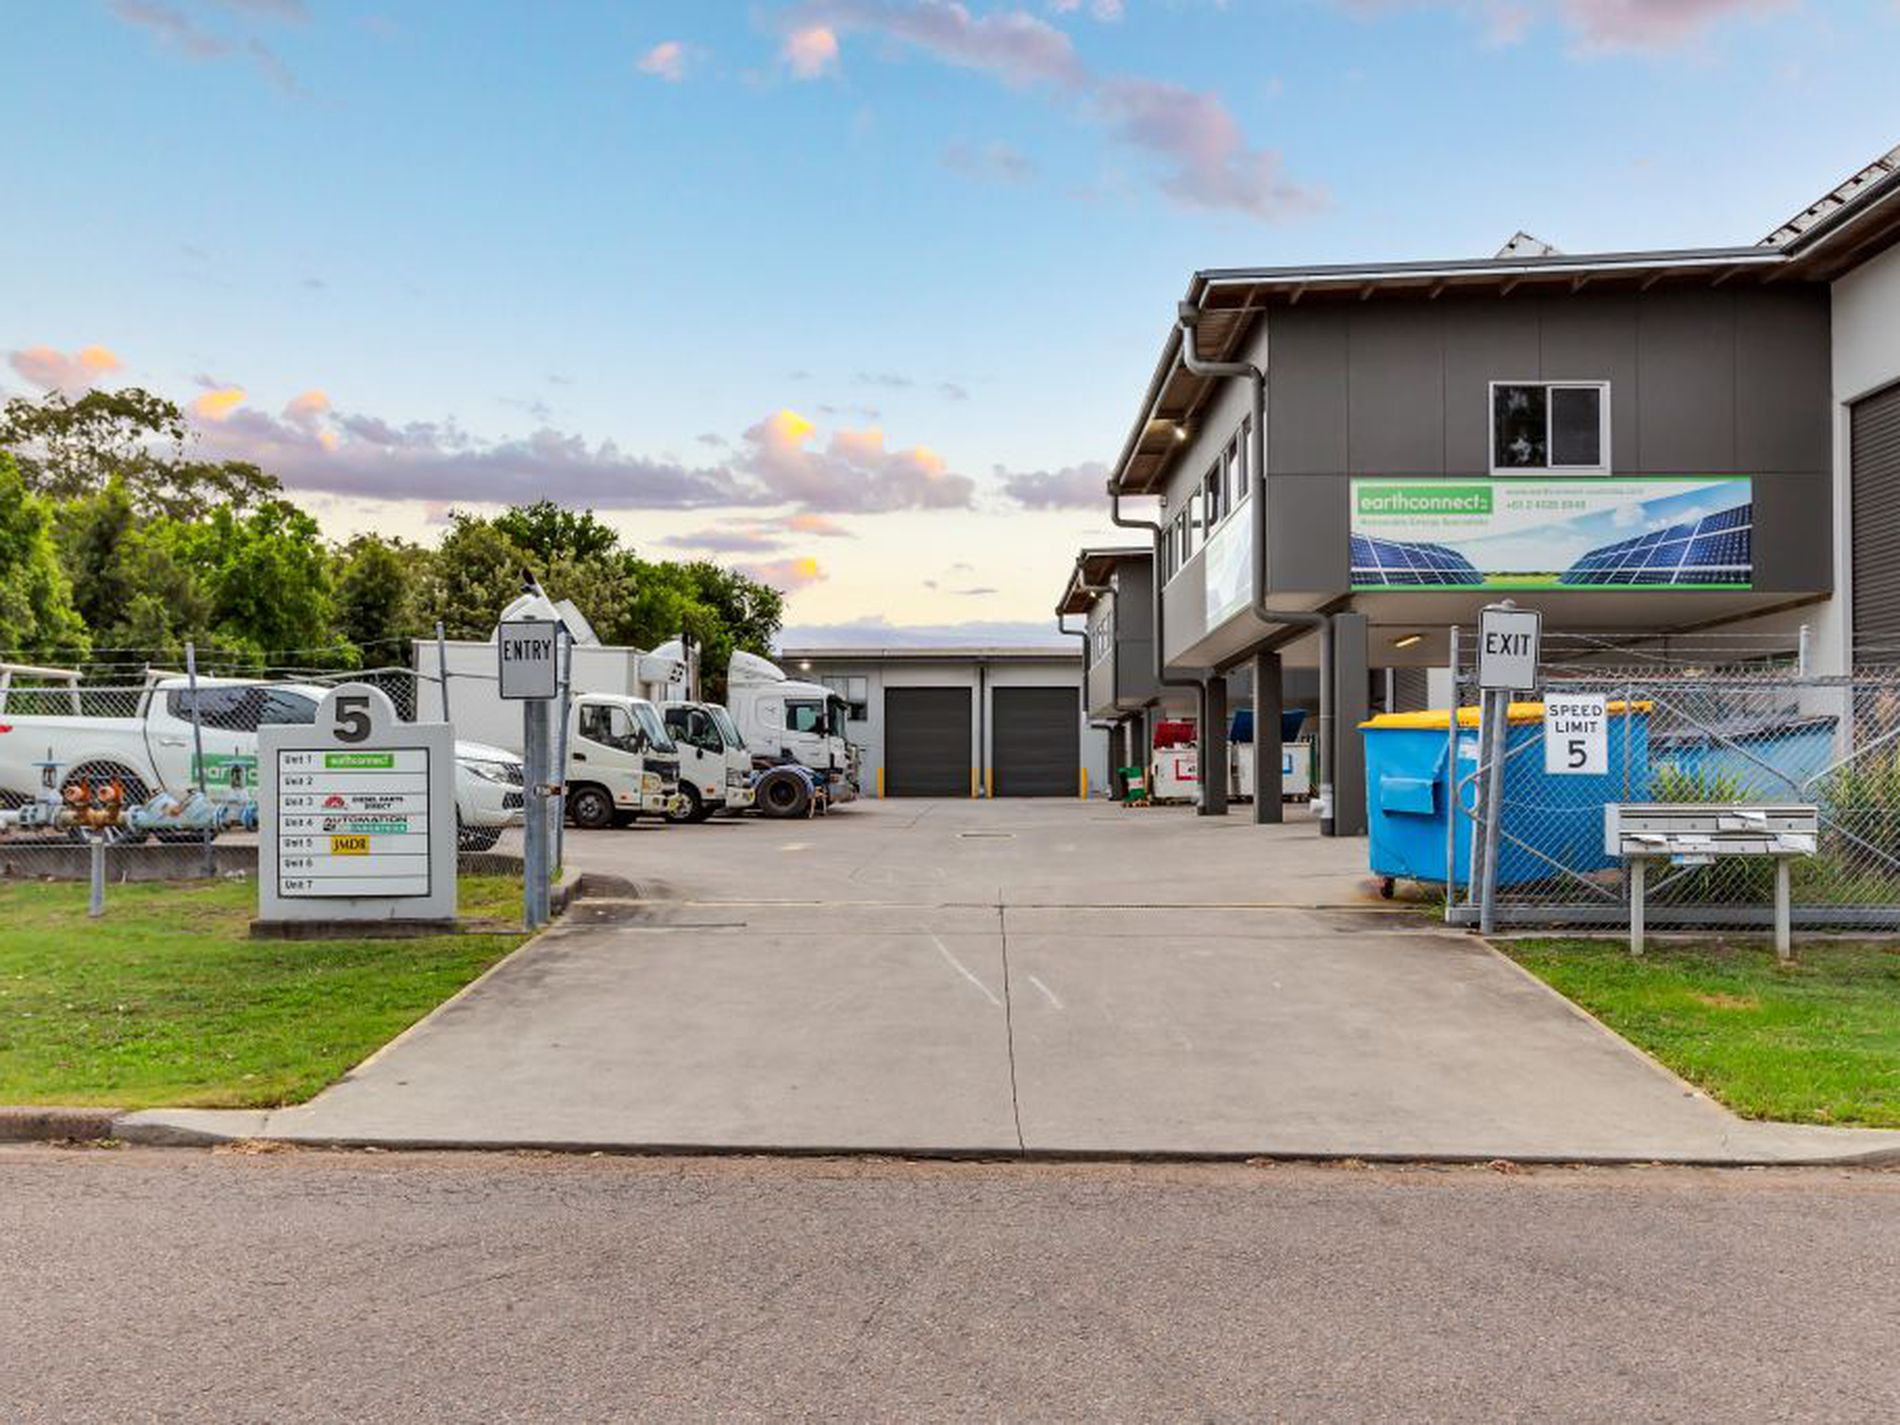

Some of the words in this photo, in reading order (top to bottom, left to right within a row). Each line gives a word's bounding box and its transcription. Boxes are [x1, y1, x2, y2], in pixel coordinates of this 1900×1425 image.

[503, 639, 552, 661] ENTRY
[1486, 633, 1532, 656] EXIT
[1549, 704, 1603, 717] SPEED
[333, 696, 373, 744] 5
[1555, 721, 1598, 733] LIMIT
[306, 754, 314, 765] 1
[1568, 740, 1588, 768] 5
[306, 775, 314, 786] 2
[306, 796, 314, 807] 3
[306, 816, 314, 827] 4
[324, 816, 408, 824] AUTOMATION
[306, 837, 314, 848] 5
[306, 857, 314, 868] 6
[306, 879, 314, 890] 7
